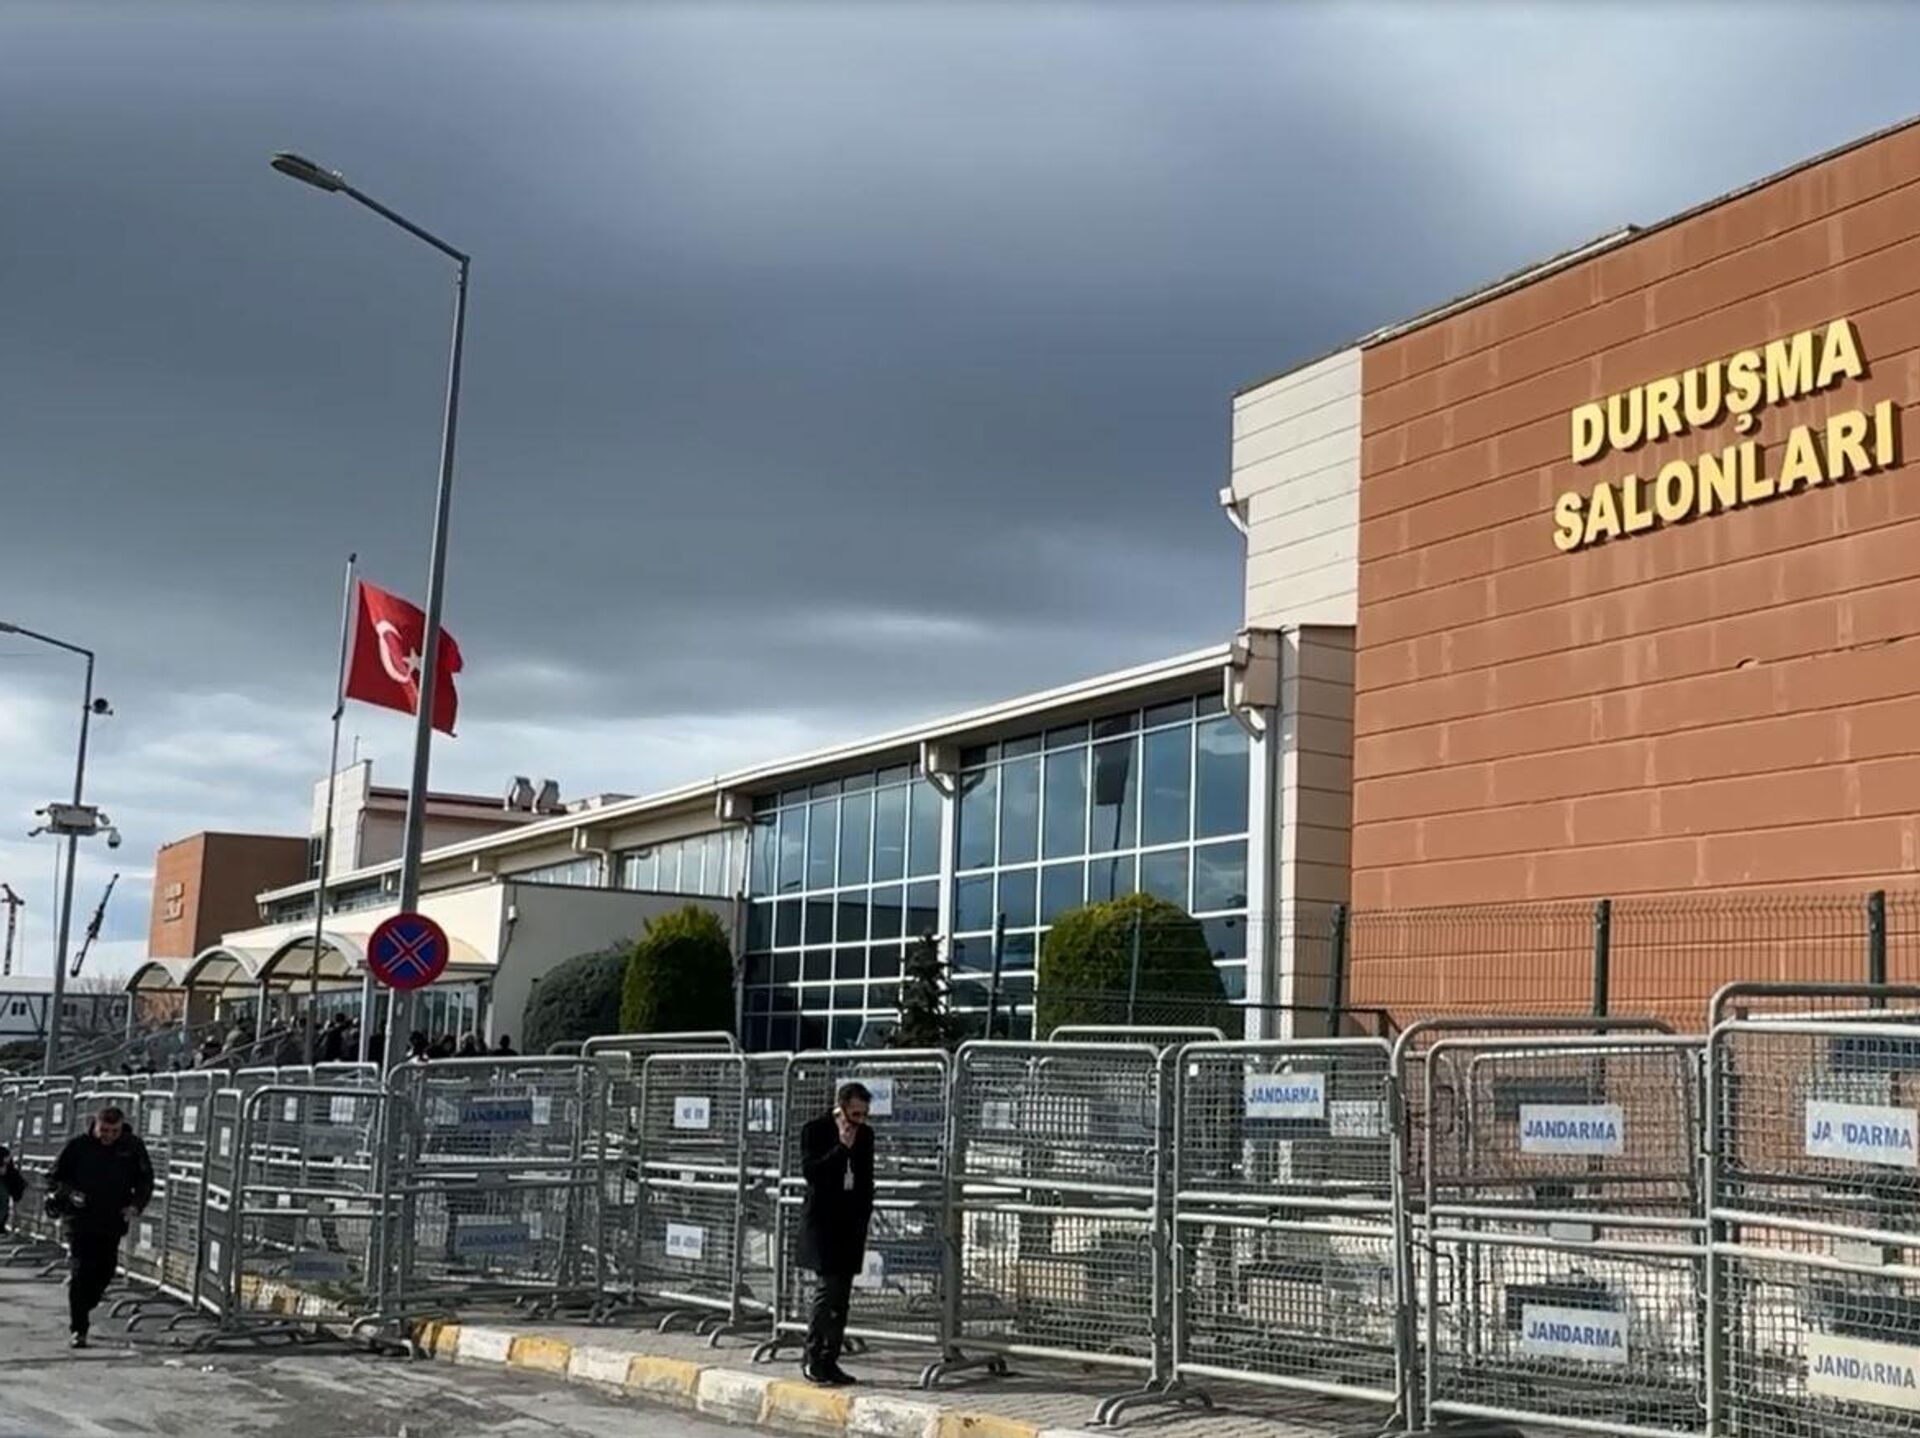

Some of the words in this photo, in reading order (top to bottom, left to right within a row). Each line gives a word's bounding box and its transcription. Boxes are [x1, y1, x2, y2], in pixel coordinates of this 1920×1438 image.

[1571, 317, 1864, 464] DURUŞMA
[1552, 400, 1897, 552] SALONLARI
[1249, 1087, 1320, 1104] JANDARMA
[1524, 1120, 1617, 1140] JANDARMA
[1527, 1321, 1622, 1349] JANDARMA
[1813, 1354, 1916, 1390] JANDARMA
